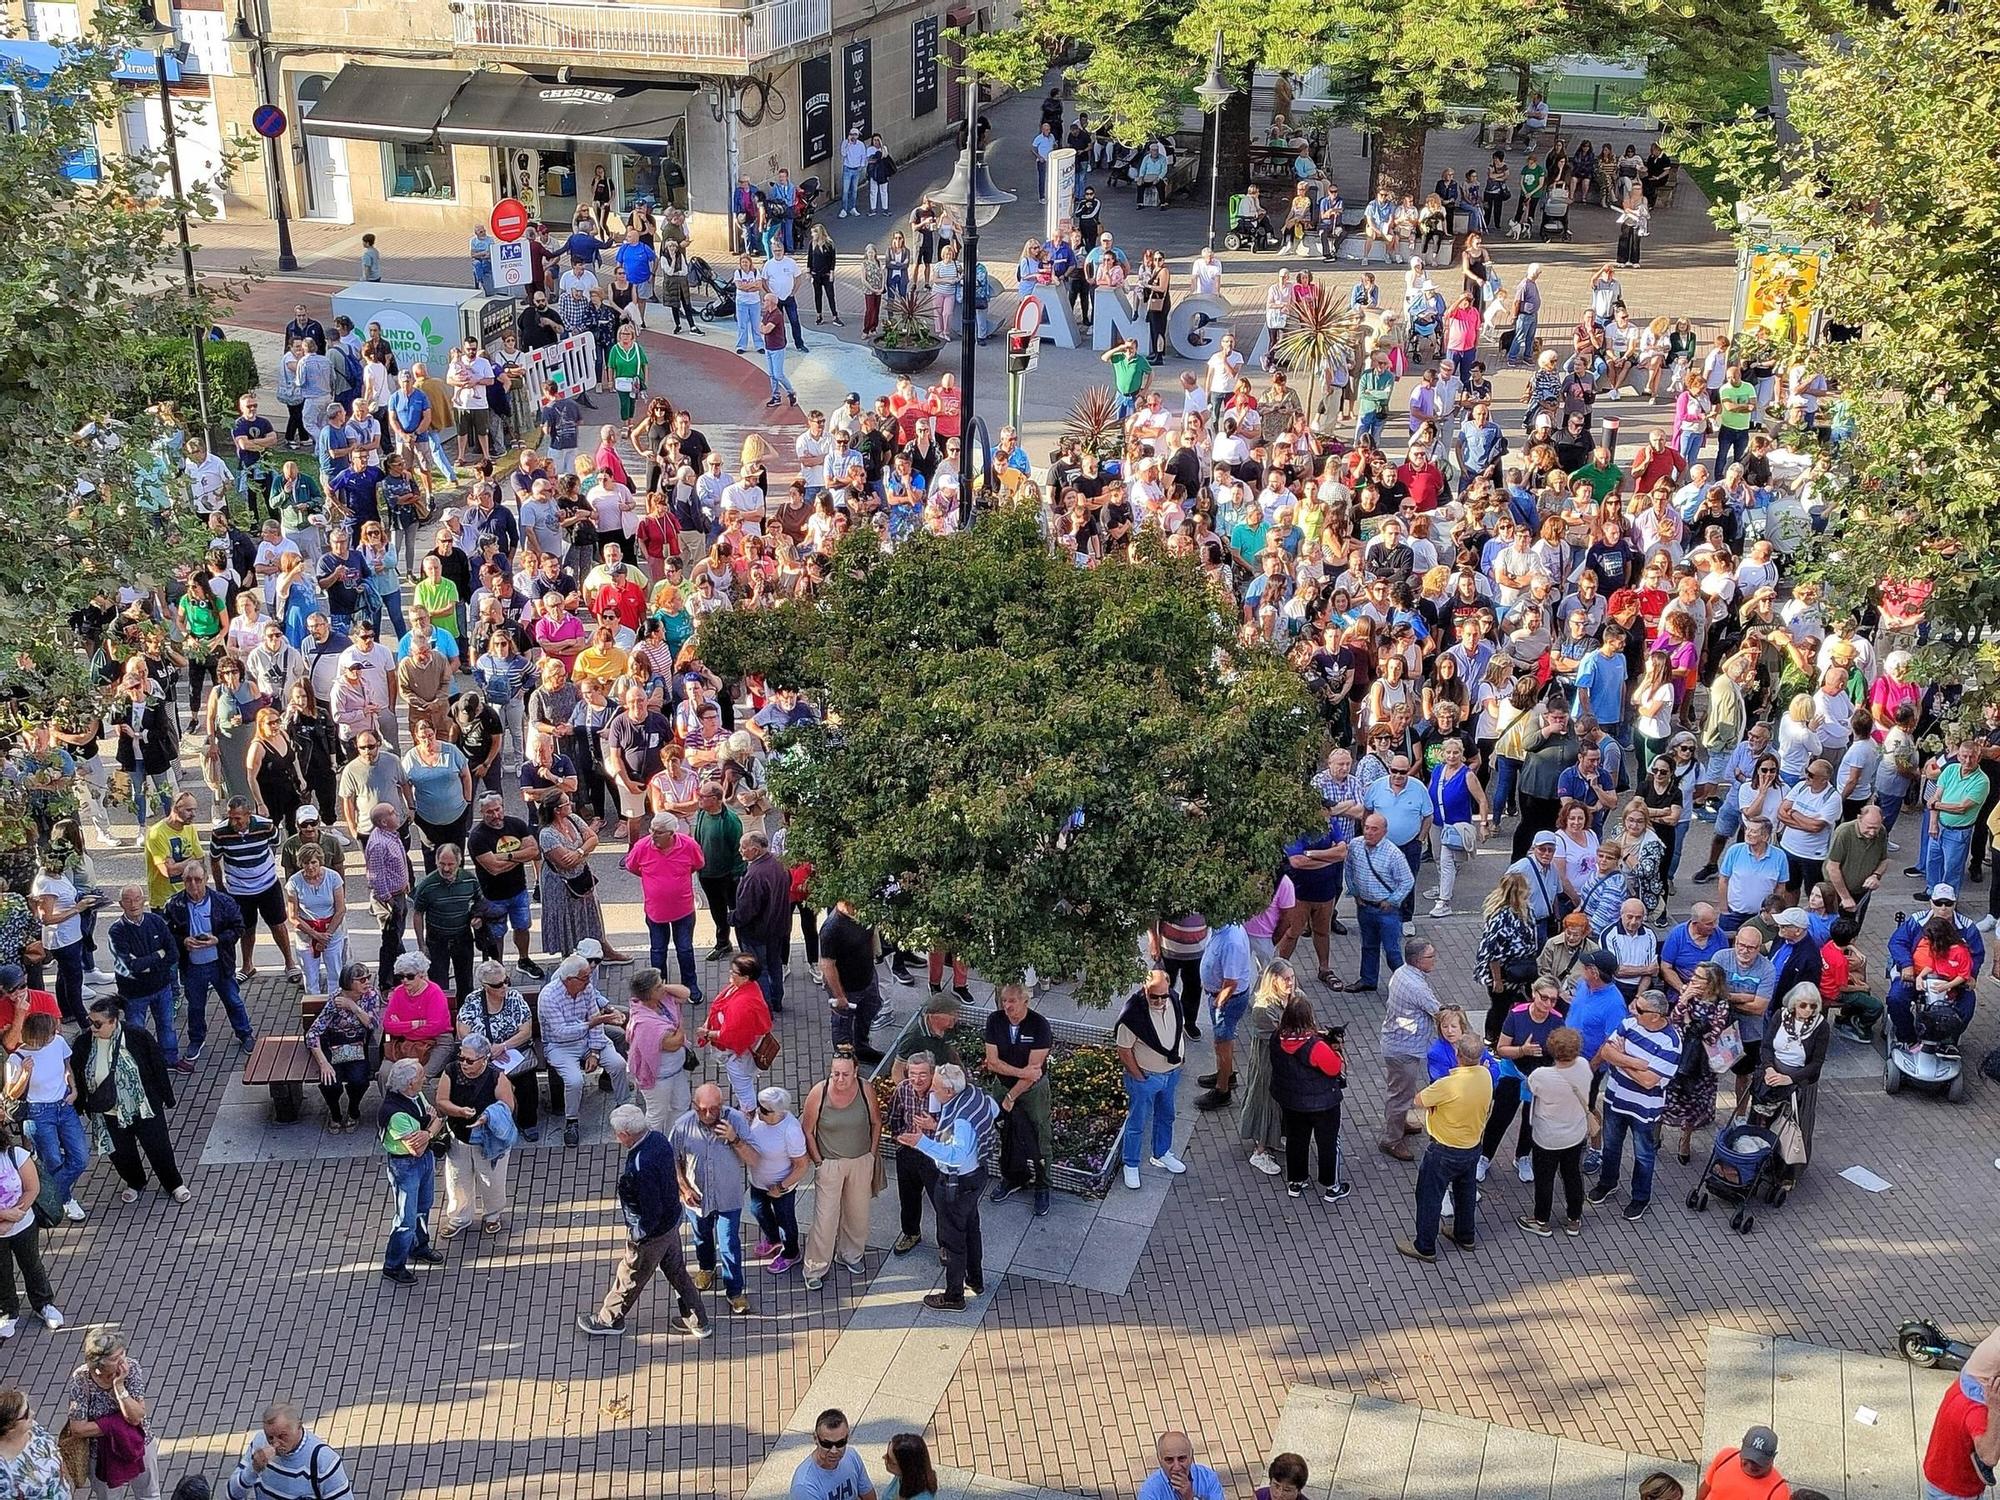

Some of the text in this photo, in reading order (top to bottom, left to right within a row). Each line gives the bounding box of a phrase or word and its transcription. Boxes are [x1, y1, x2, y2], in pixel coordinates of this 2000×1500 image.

[127, 64, 157, 75] travel
[539, 88, 616, 103] CHESTER
[508, 272, 518, 280] 20
[381, 328, 416, 340] UNTO
[390, 340, 422, 352] IMPO
[395, 351, 448, 366] XIMIDAD
